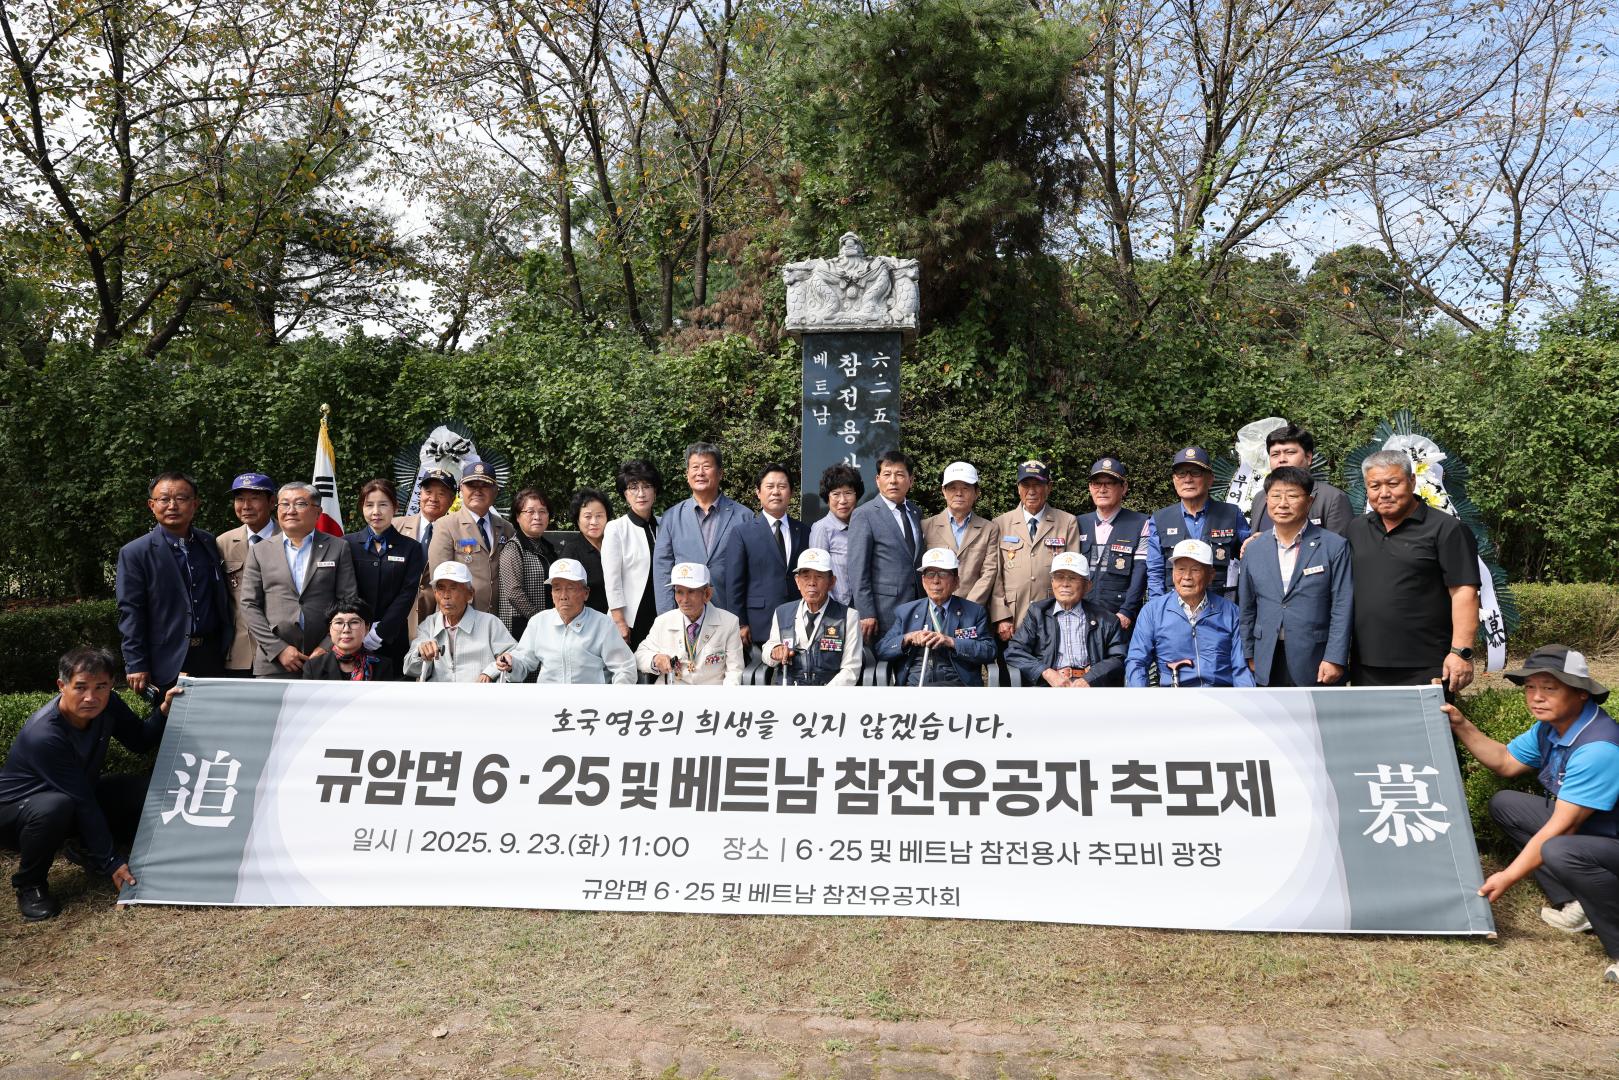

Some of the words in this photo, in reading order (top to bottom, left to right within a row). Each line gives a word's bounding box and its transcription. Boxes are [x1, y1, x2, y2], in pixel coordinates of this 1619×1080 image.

[812, 351, 830, 425] 베트남
[695, 709, 778, 739] 희생을
[793, 712, 846, 739] 잊지
[860, 712, 1012, 740] 않겠습니다.
[161, 750, 241, 827] 追
[316, 749, 462, 806] 규암면
[621, 762, 659, 810] 및
[670, 756, 824, 814] 베트남
[835, 757, 1098, 816] 참전유공자
[1111, 760, 1276, 817] 추모제
[1353, 763, 1451, 847] 慕
[354, 828, 397, 851] 일시
[421, 831, 491, 852] 2025.
[500, 833, 519, 853] 9.
[619, 836, 689, 857] 11:00
[724, 838, 768, 860] 장소
[871, 840, 890, 863] 및
[900, 840, 972, 864] 베트남
[981, 841, 1080, 865] 참전용사
[1089, 842, 1162, 866] 추모비
[1172, 843, 1222, 867] 광장
[583, 880, 647, 900] 규암면
[722, 883, 741, 902] 및
[749, 884, 816, 903] 베트남
[823, 885, 959, 906] 참전유공자회
